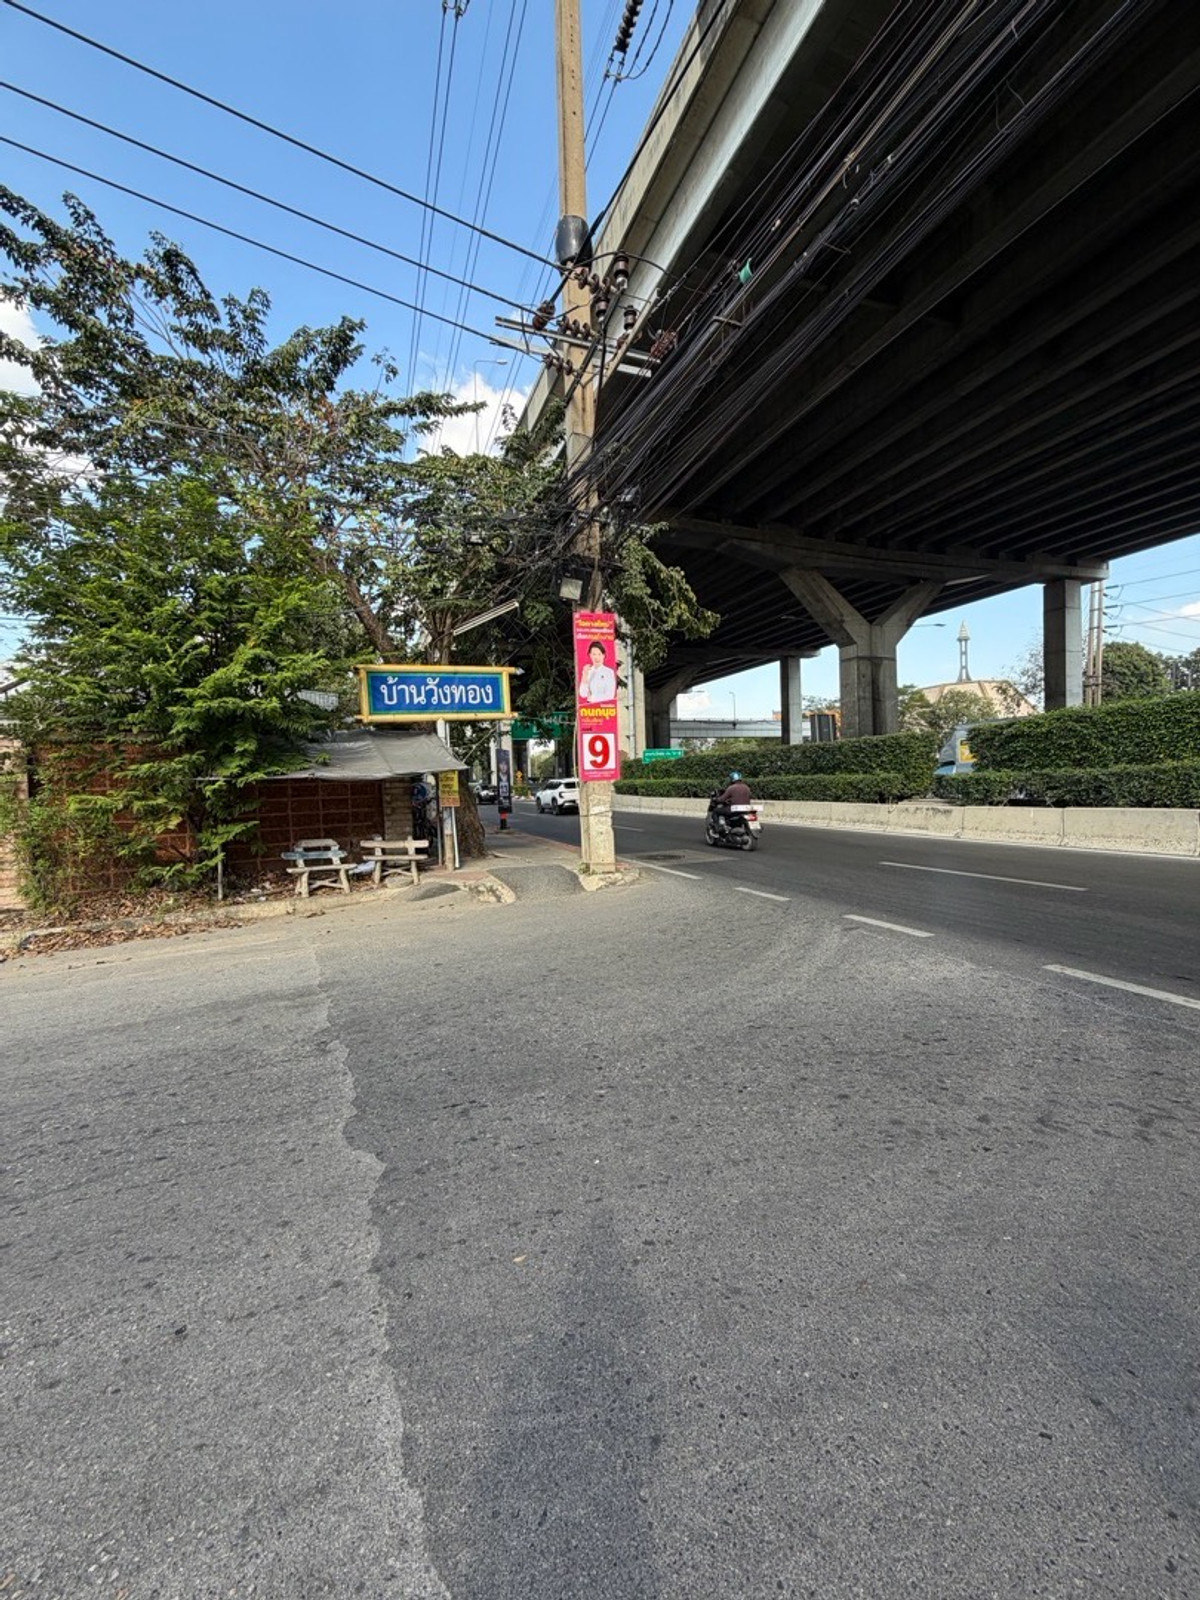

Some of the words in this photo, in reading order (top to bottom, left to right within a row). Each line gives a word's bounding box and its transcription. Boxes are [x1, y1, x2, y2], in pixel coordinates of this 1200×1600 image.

[380, 676, 493, 705] บ้านวังทอง
[588, 735, 610, 769] 9
